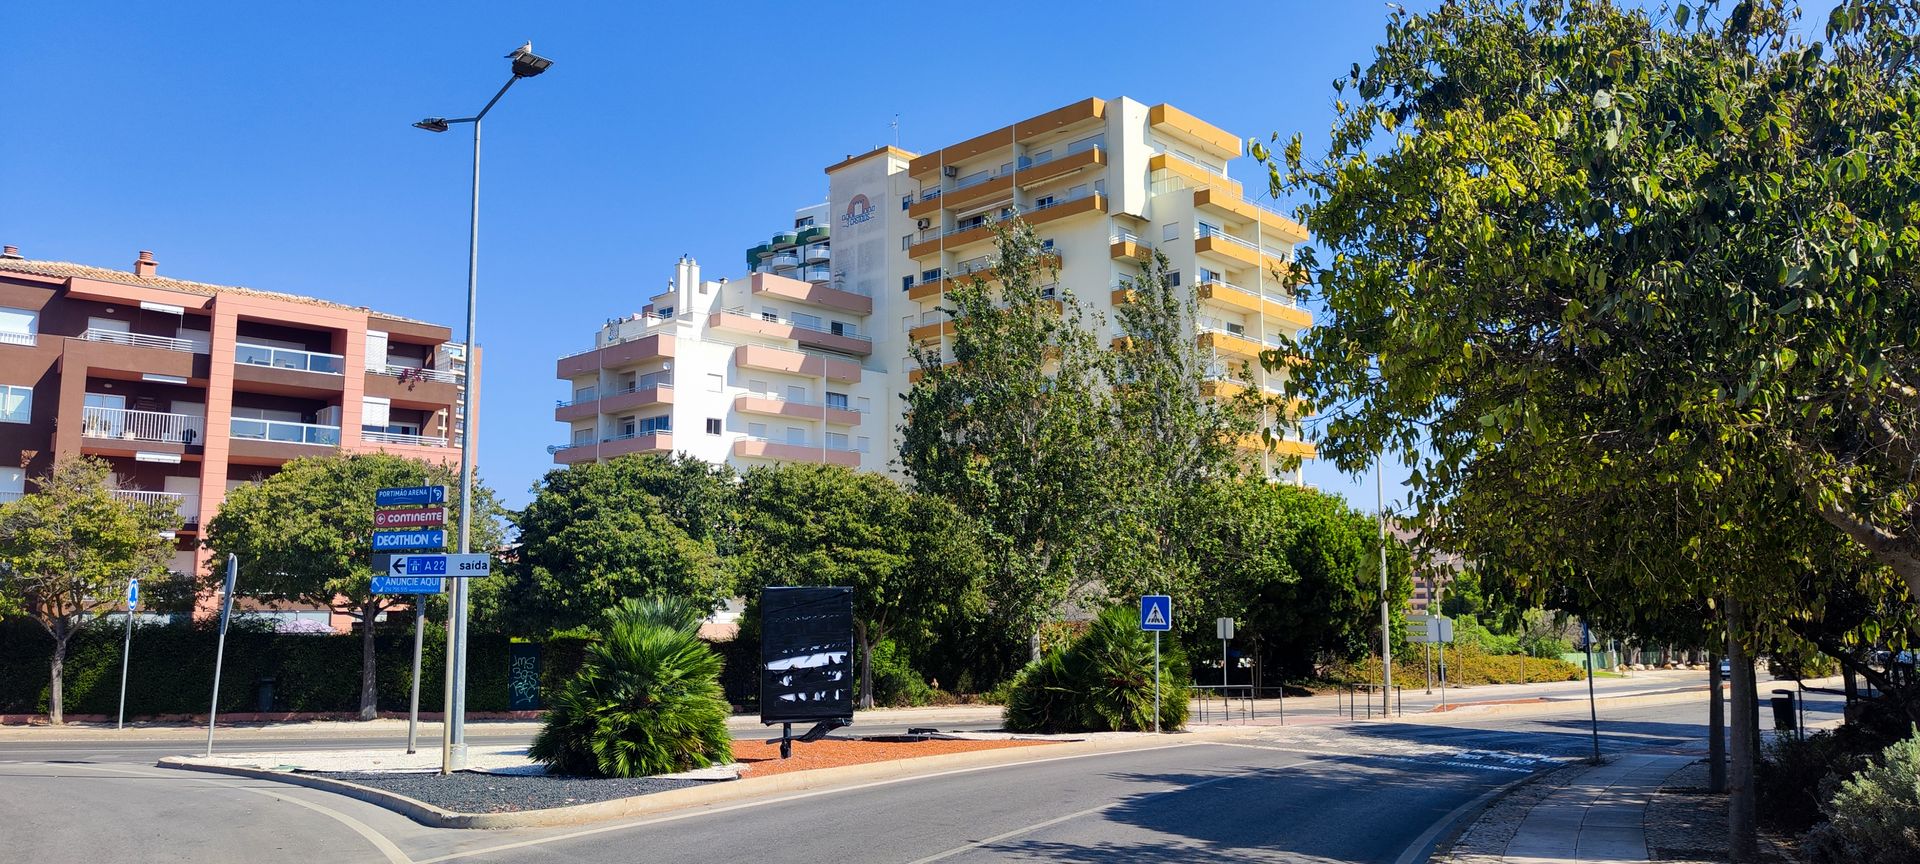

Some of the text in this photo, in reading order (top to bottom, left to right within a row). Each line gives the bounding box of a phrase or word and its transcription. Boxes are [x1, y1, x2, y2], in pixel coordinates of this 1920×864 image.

[379, 488, 407, 498] PORTIMÃO
[387, 511, 442, 523] CONTINENTE
[377, 534, 428, 546] DECATHLON
[424, 560, 445, 571] A 22
[459, 560, 488, 570] saída
[385, 577, 439, 586] ANUNCIE AQUI
